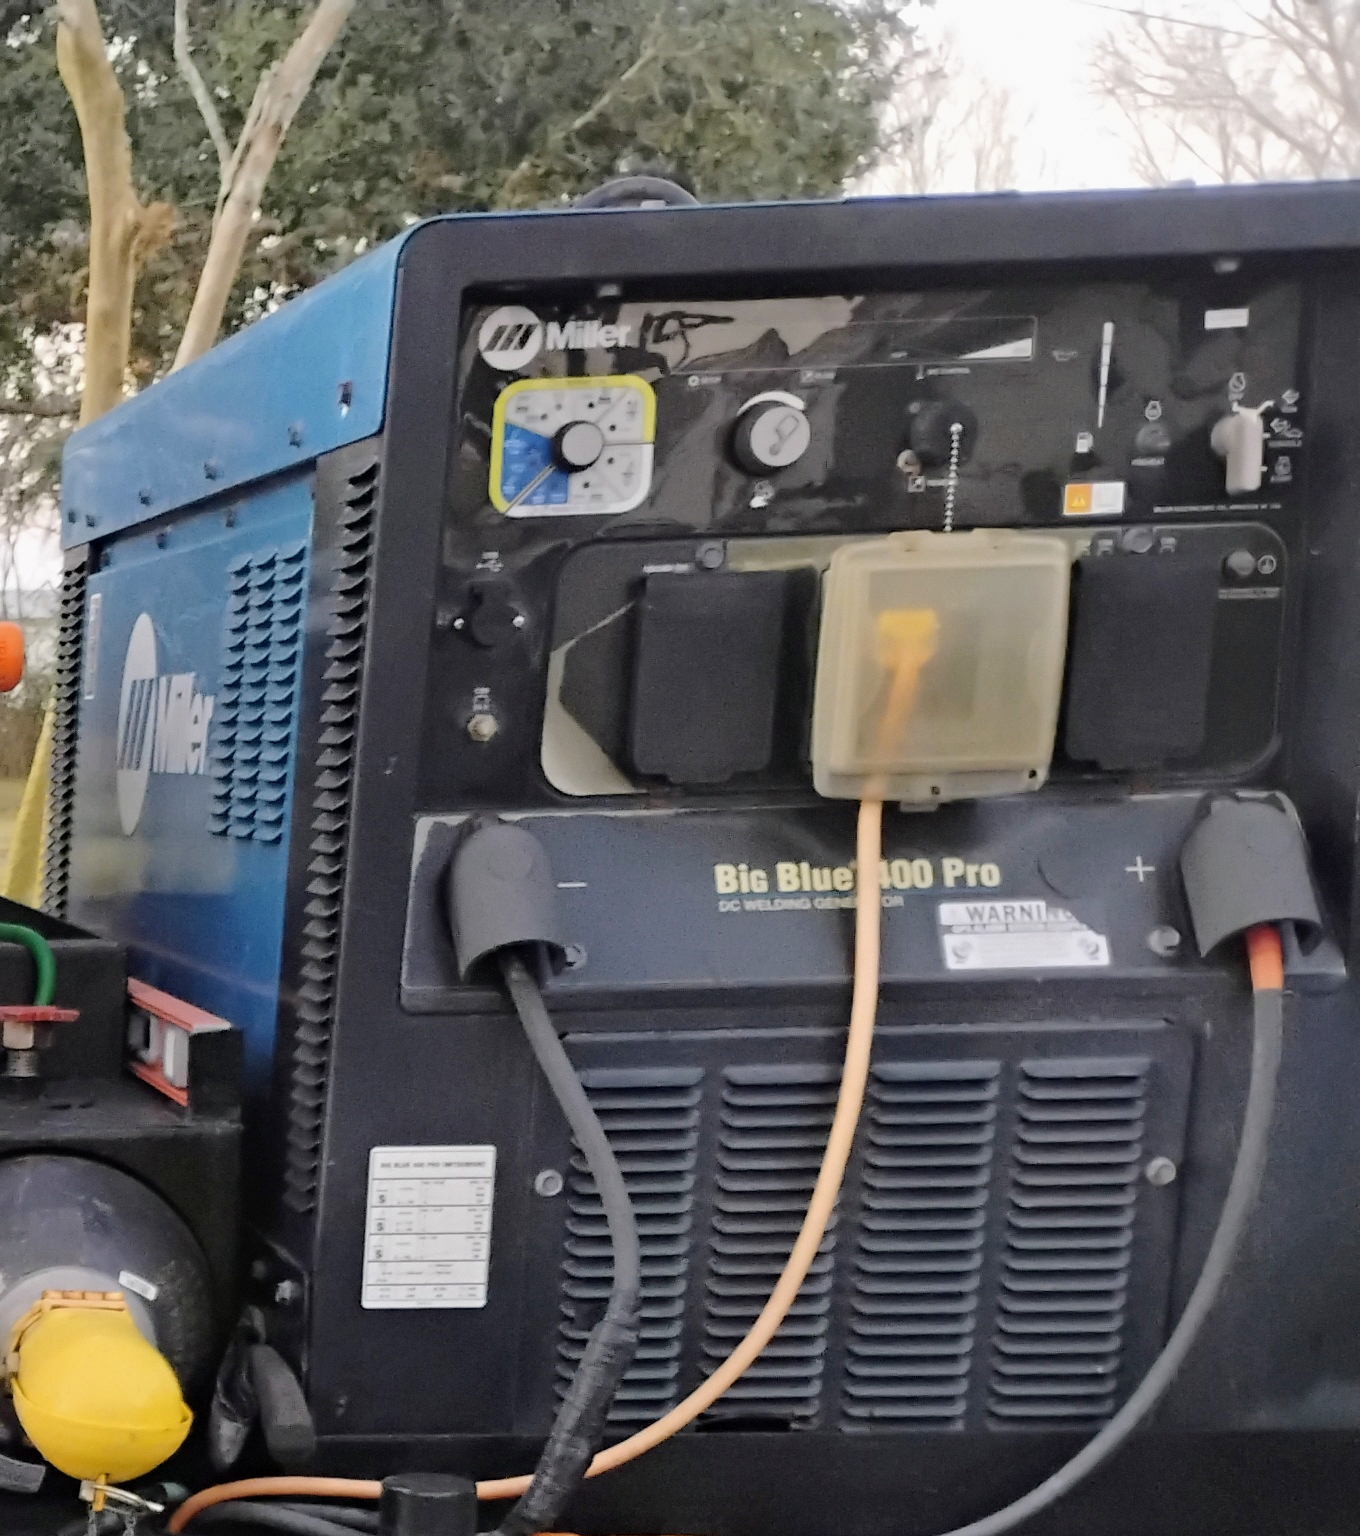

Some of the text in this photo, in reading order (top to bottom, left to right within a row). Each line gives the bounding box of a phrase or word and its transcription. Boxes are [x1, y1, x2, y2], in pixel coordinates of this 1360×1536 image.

[546, 319, 632, 351] Miller
[152, 672, 216, 777] Miller
[775, 861, 855, 893] Blue
[941, 857, 1002, 889] Pro
